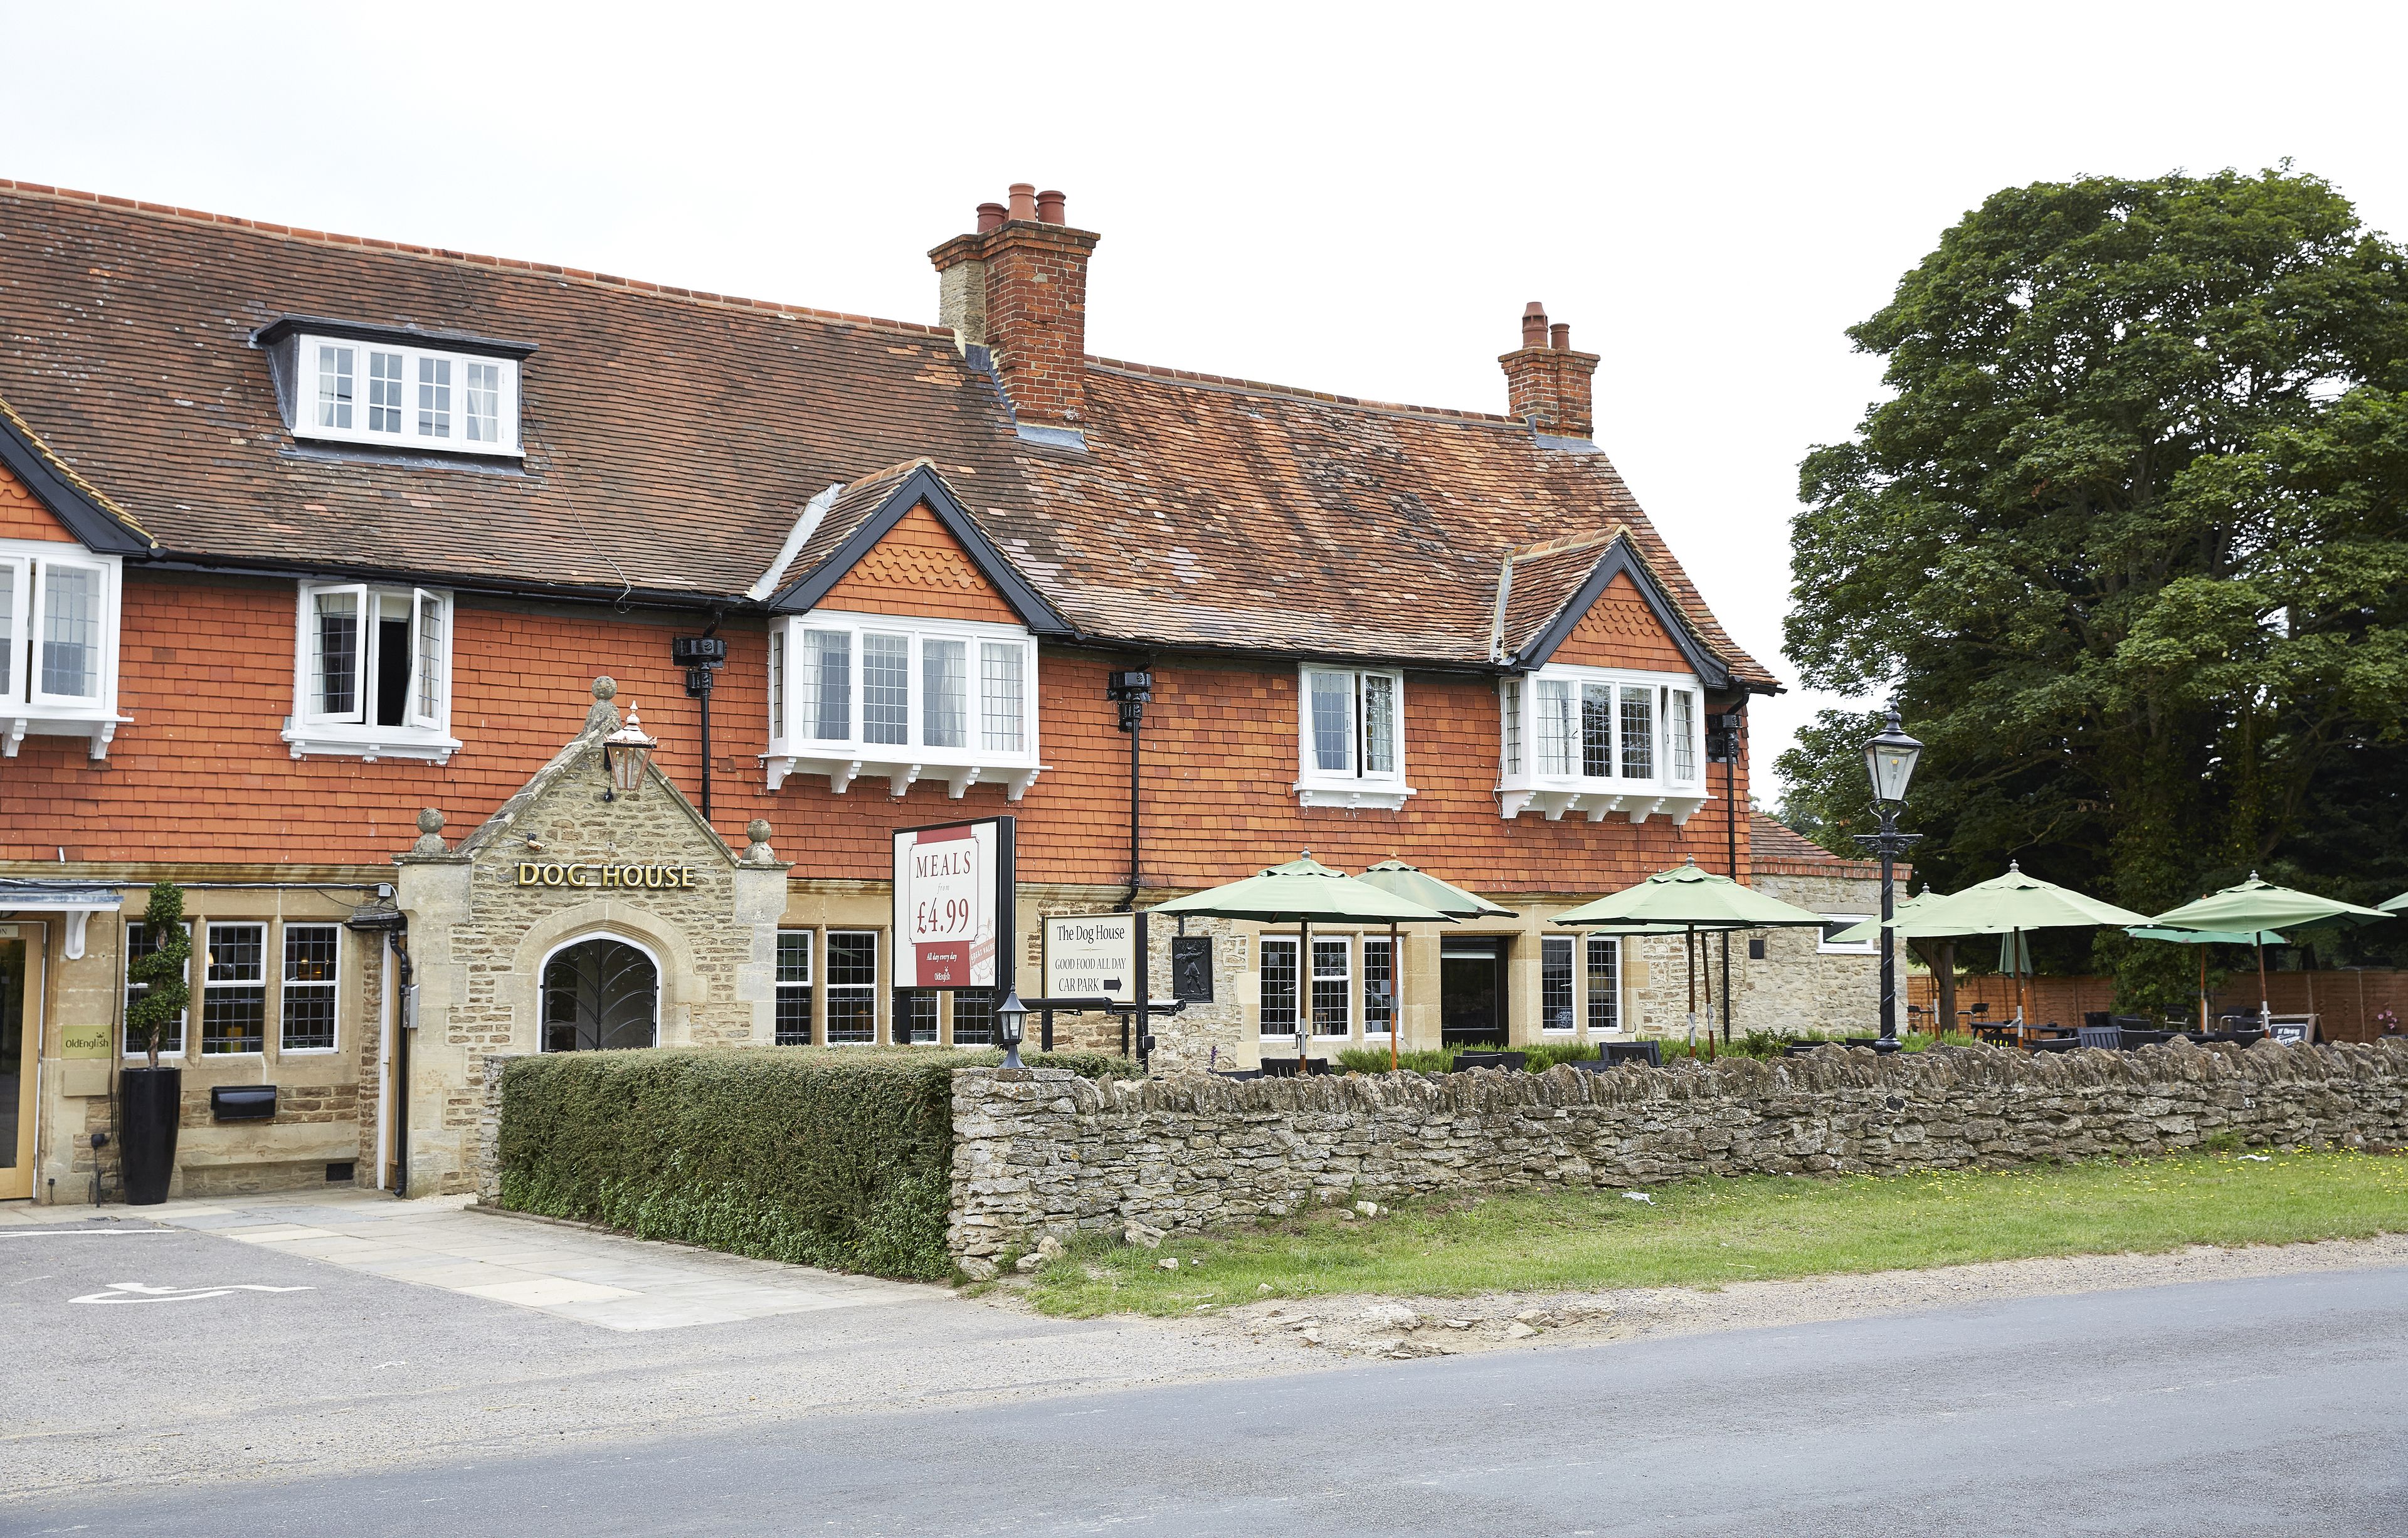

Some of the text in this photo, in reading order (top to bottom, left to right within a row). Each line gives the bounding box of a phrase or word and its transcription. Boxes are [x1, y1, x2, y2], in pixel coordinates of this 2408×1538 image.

[916, 851, 971, 878] MEALS
[518, 861, 696, 888] DOG HOUSE
[937, 882, 949, 895] from
[917, 897, 969, 934] £4.99
[1057, 925, 1125, 944] The Dog House
[939, 954, 949, 962] every
[970, 942, 995, 961] GREAT VALUE
[1055, 957, 1126, 970] GOOD FOOD ALL DAY
[1059, 977, 1099, 992] CAR PARK
[65, 1038, 108, 1050] OldEnglish
